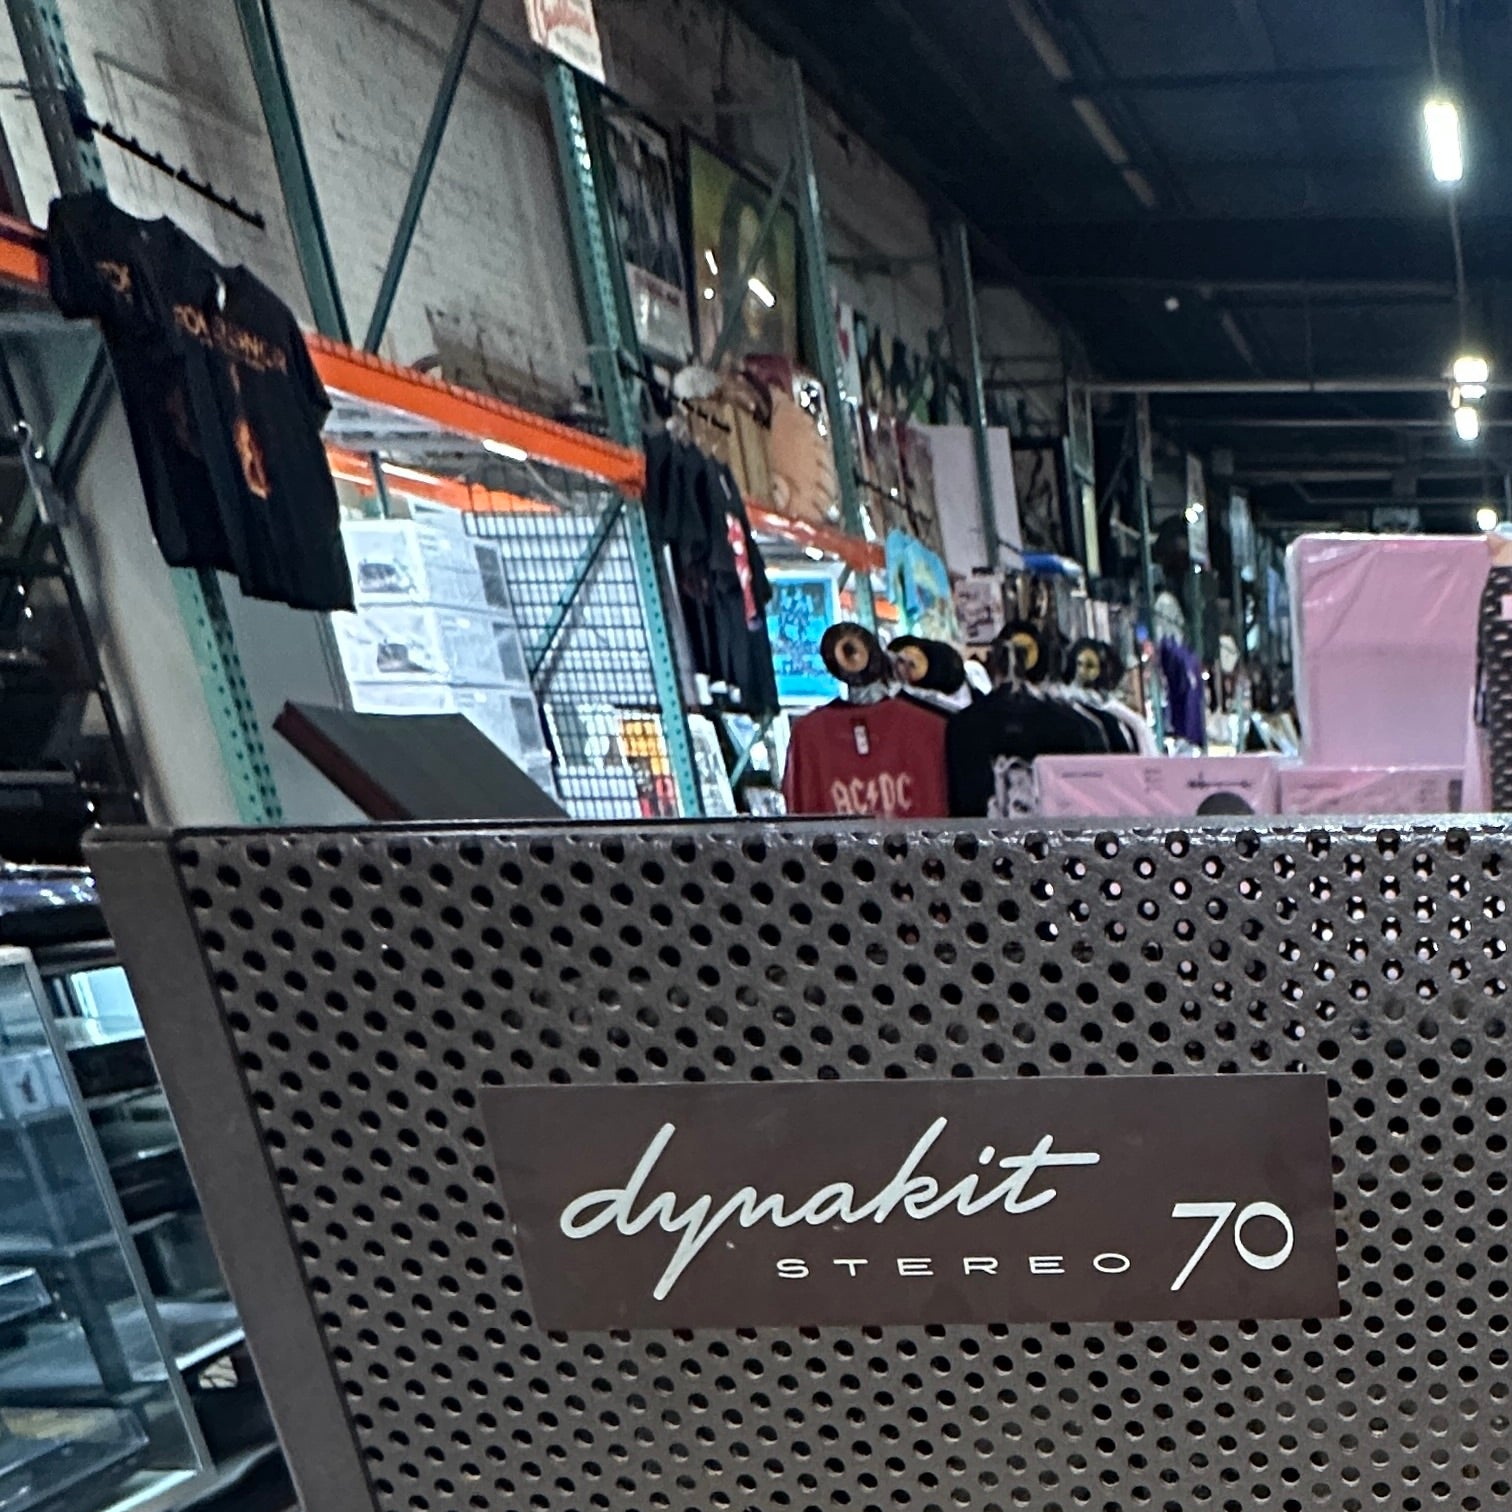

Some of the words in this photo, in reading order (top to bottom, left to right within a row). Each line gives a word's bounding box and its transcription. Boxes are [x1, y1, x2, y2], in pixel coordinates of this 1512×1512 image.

[559, 1116, 1101, 1301] dynakit
[776, 1252, 1131, 1279] STEREO
[1170, 1201, 1294, 1291] 70
